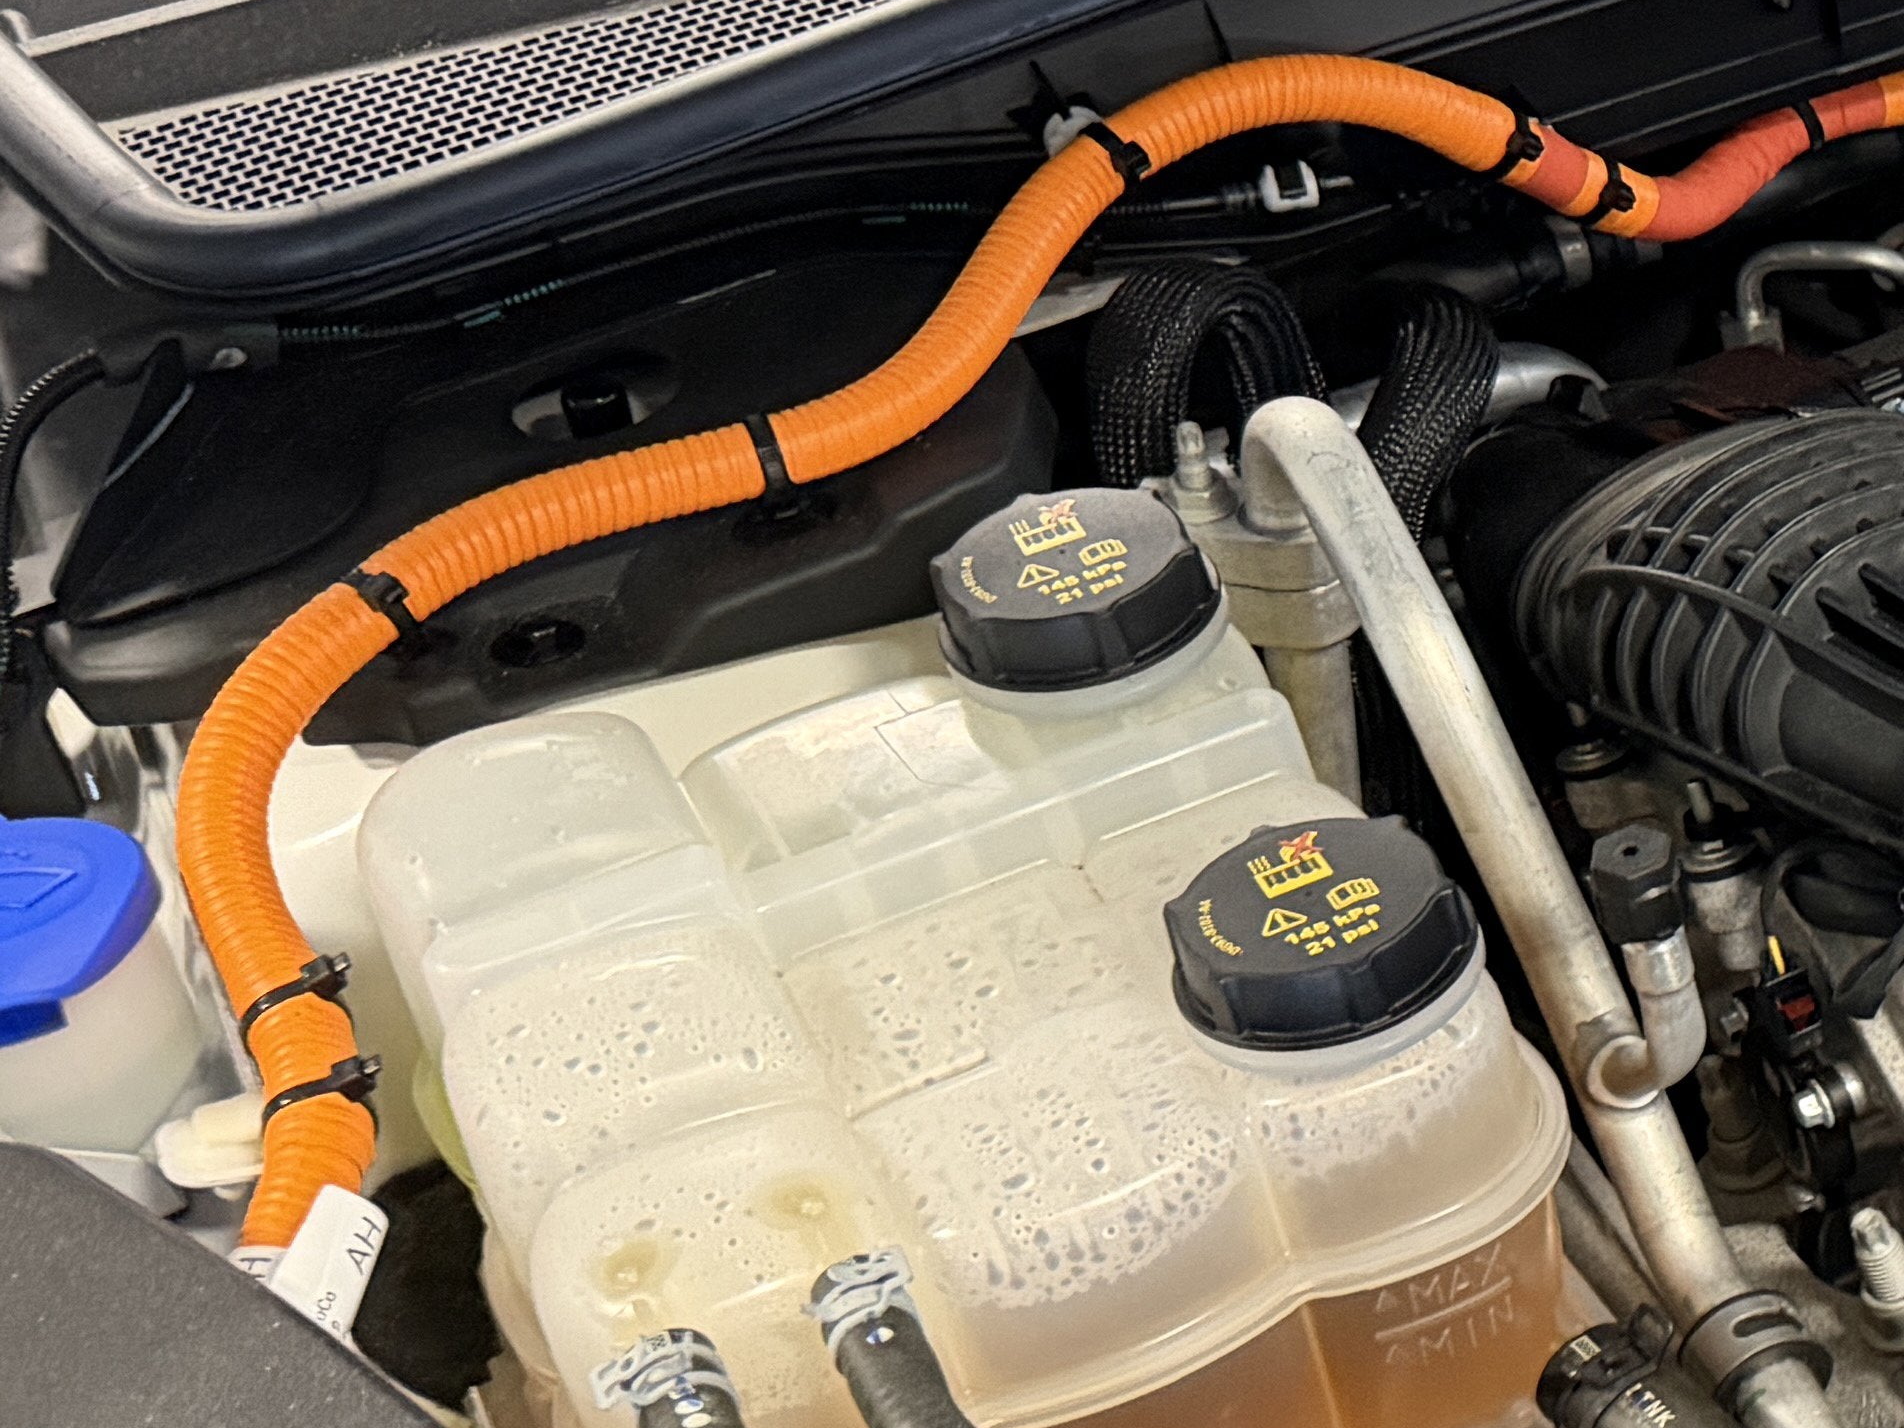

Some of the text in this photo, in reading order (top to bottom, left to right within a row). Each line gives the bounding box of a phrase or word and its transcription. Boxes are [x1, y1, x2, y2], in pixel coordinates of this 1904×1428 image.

[1038, 561, 1128, 595] 145 kPa
[1055, 574, 1124, 605] 21 psi
[1284, 903, 1382, 945] 145 kPa
[1305, 919, 1380, 957] 21 psi
[346, 1216, 381, 1276] AH
[1408, 1244, 1502, 1314] MAX
[1420, 1294, 1514, 1364] MIN
